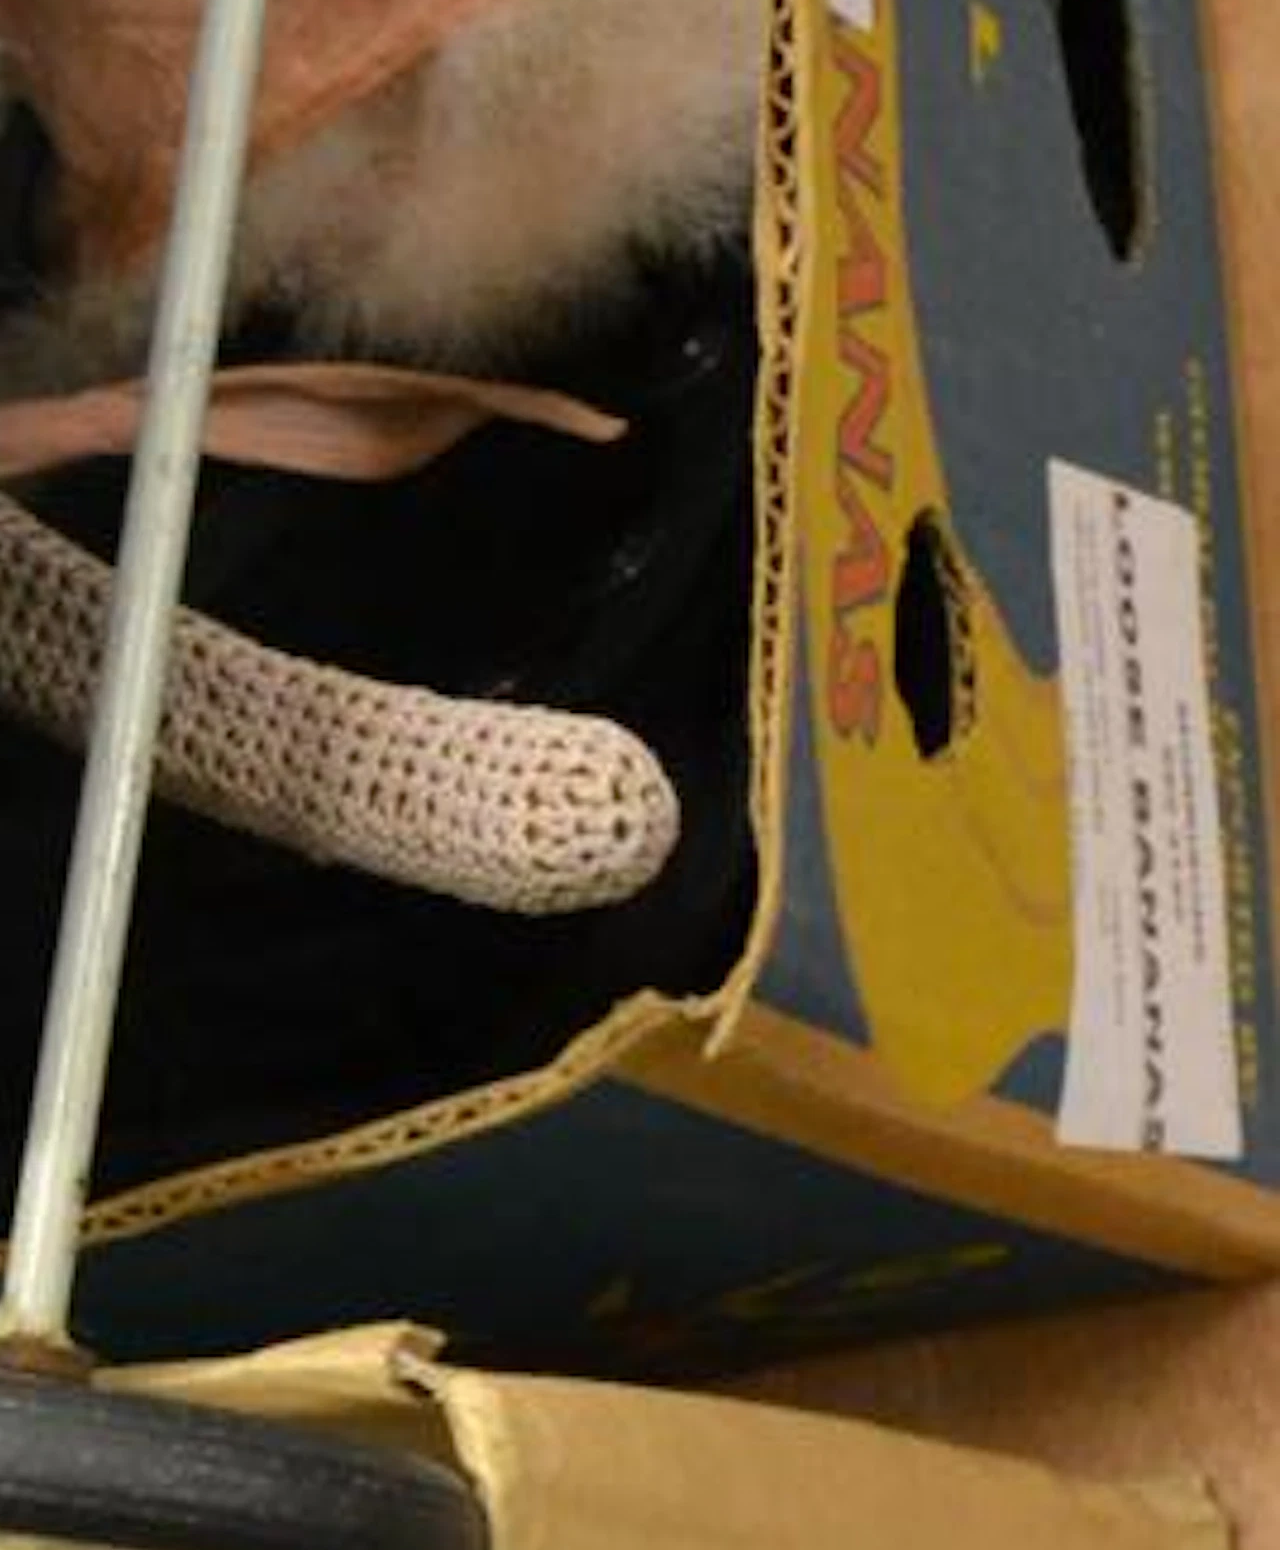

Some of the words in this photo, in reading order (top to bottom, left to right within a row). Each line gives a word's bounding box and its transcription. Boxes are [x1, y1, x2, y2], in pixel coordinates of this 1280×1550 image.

[826, 50, 894, 749] NANAS
[1109, 490, 1149, 749] LOOSE
[1130, 779, 1168, 1156] BANANAS
